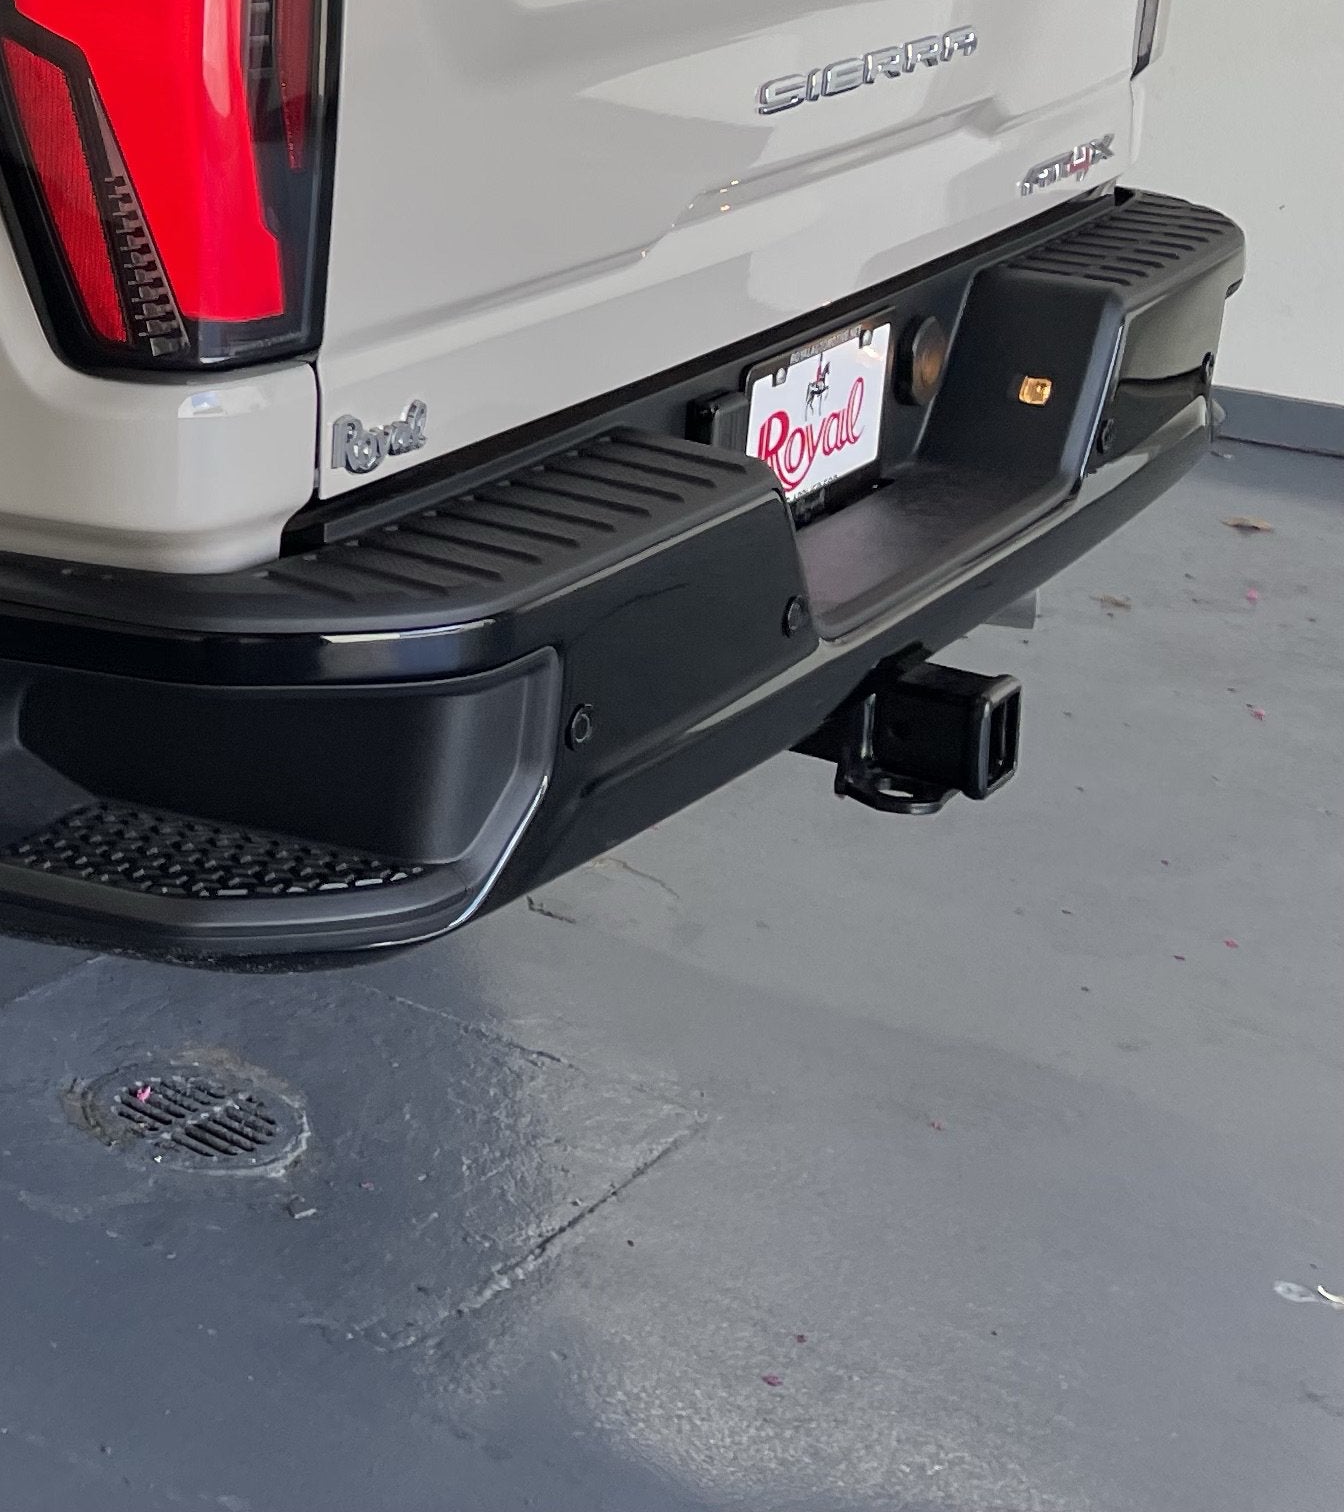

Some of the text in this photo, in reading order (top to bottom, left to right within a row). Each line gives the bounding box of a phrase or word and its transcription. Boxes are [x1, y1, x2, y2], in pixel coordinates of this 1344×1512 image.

[758, 24, 978, 115] SIERRA
[331, 399, 428, 475] Royal
[757, 376, 866, 492] Royal
